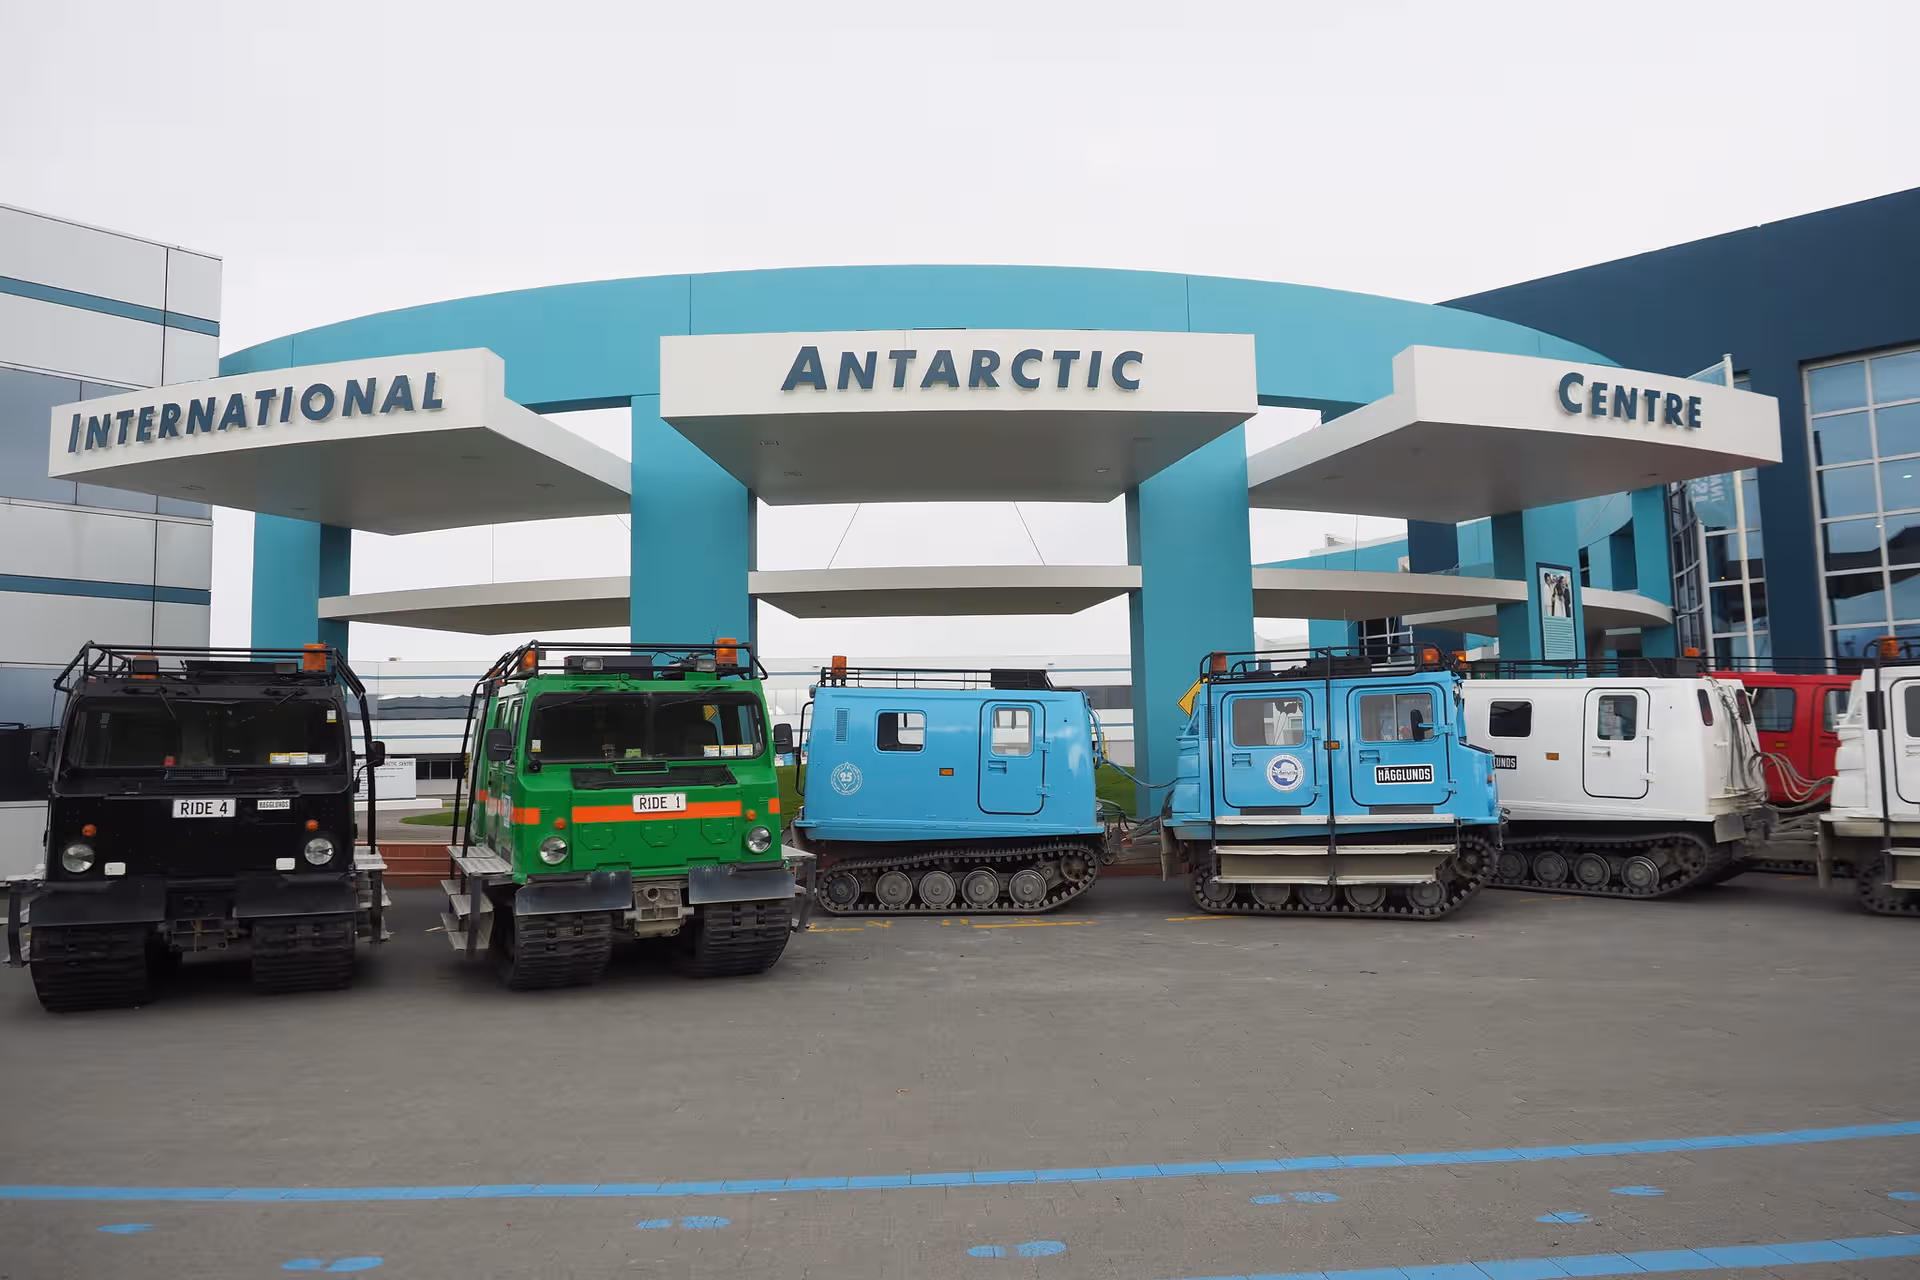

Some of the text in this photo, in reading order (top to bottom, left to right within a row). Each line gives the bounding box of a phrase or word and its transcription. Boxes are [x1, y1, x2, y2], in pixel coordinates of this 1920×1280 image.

[780, 346, 1144, 391] ANTARCTIC
[1558, 372, 1702, 428] CENTRE
[67, 371, 443, 454] INTERNATIONAL
[1493, 757, 1516, 768] LUNDS
[840, 772, 853, 782] 25
[1377, 767, 1431, 782] HÄGGLUNDS
[180, 801, 228, 815] RIDE 4
